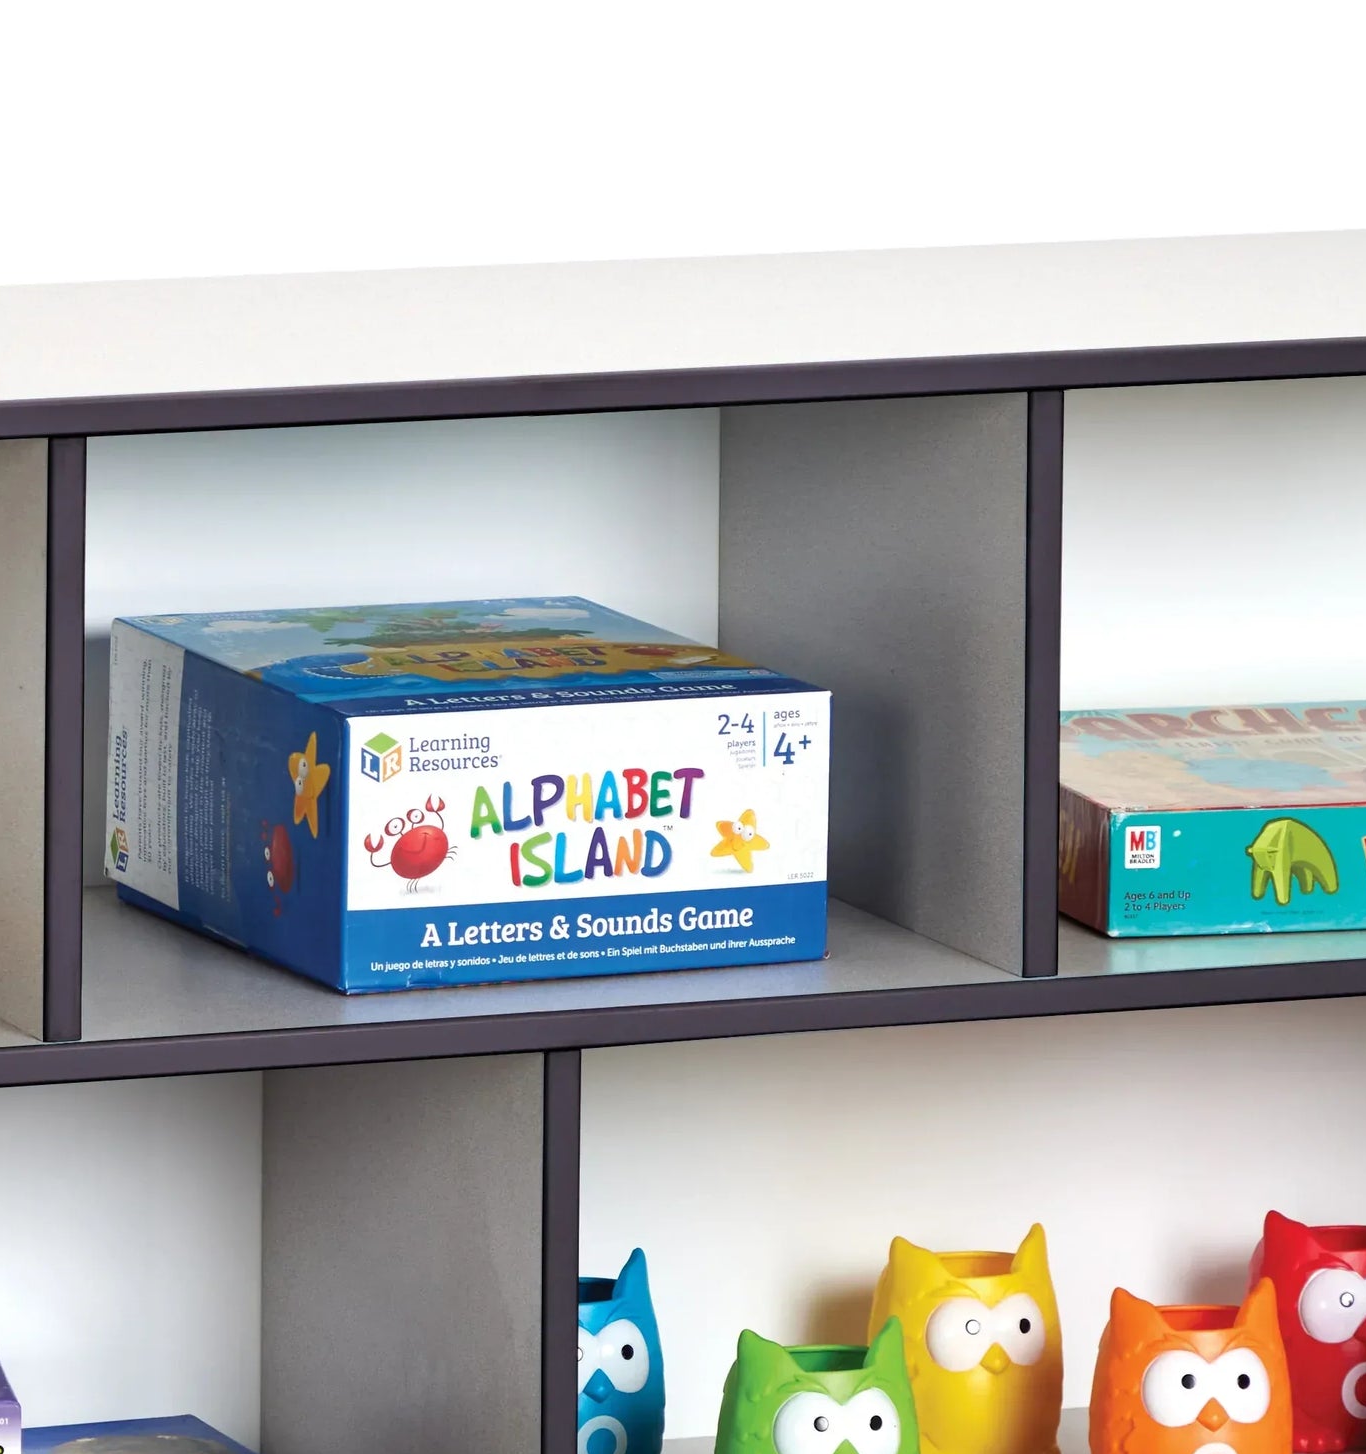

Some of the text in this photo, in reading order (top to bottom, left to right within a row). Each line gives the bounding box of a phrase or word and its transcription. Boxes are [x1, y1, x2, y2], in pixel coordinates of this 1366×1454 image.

[404, 698, 427, 707] A
[429, 692, 524, 706] Letters
[531, 689, 551, 701] &
[555, 684, 655, 699] Sounds
[661, 682, 737, 693] Game
[718, 713, 754, 735] 2-4
[774, 709, 801, 721] ages
[409, 734, 491, 753] Learning
[727, 732, 812, 765] players 4+
[410, 751, 499, 772] Resources
[114, 736, 122, 820] Learning
[470, 768, 705, 838] ALPHABET
[1130, 830, 1157, 852] MB
[510, 827, 673, 887] ISLAND
[1124, 892, 1146, 902] Ages
[1157, 891, 1175, 899] and
[1178, 891, 1191, 901] Up
[1124, 901, 1186, 912] 2 to 4 Players
[420, 906, 754, 948] A Letters & Sounds Game
[370, 935, 796, 973] Un juego de letras y sonidos Jeu de lettres et de sons Ein Spiel mit Buchstaben und ihrer Aussprache
